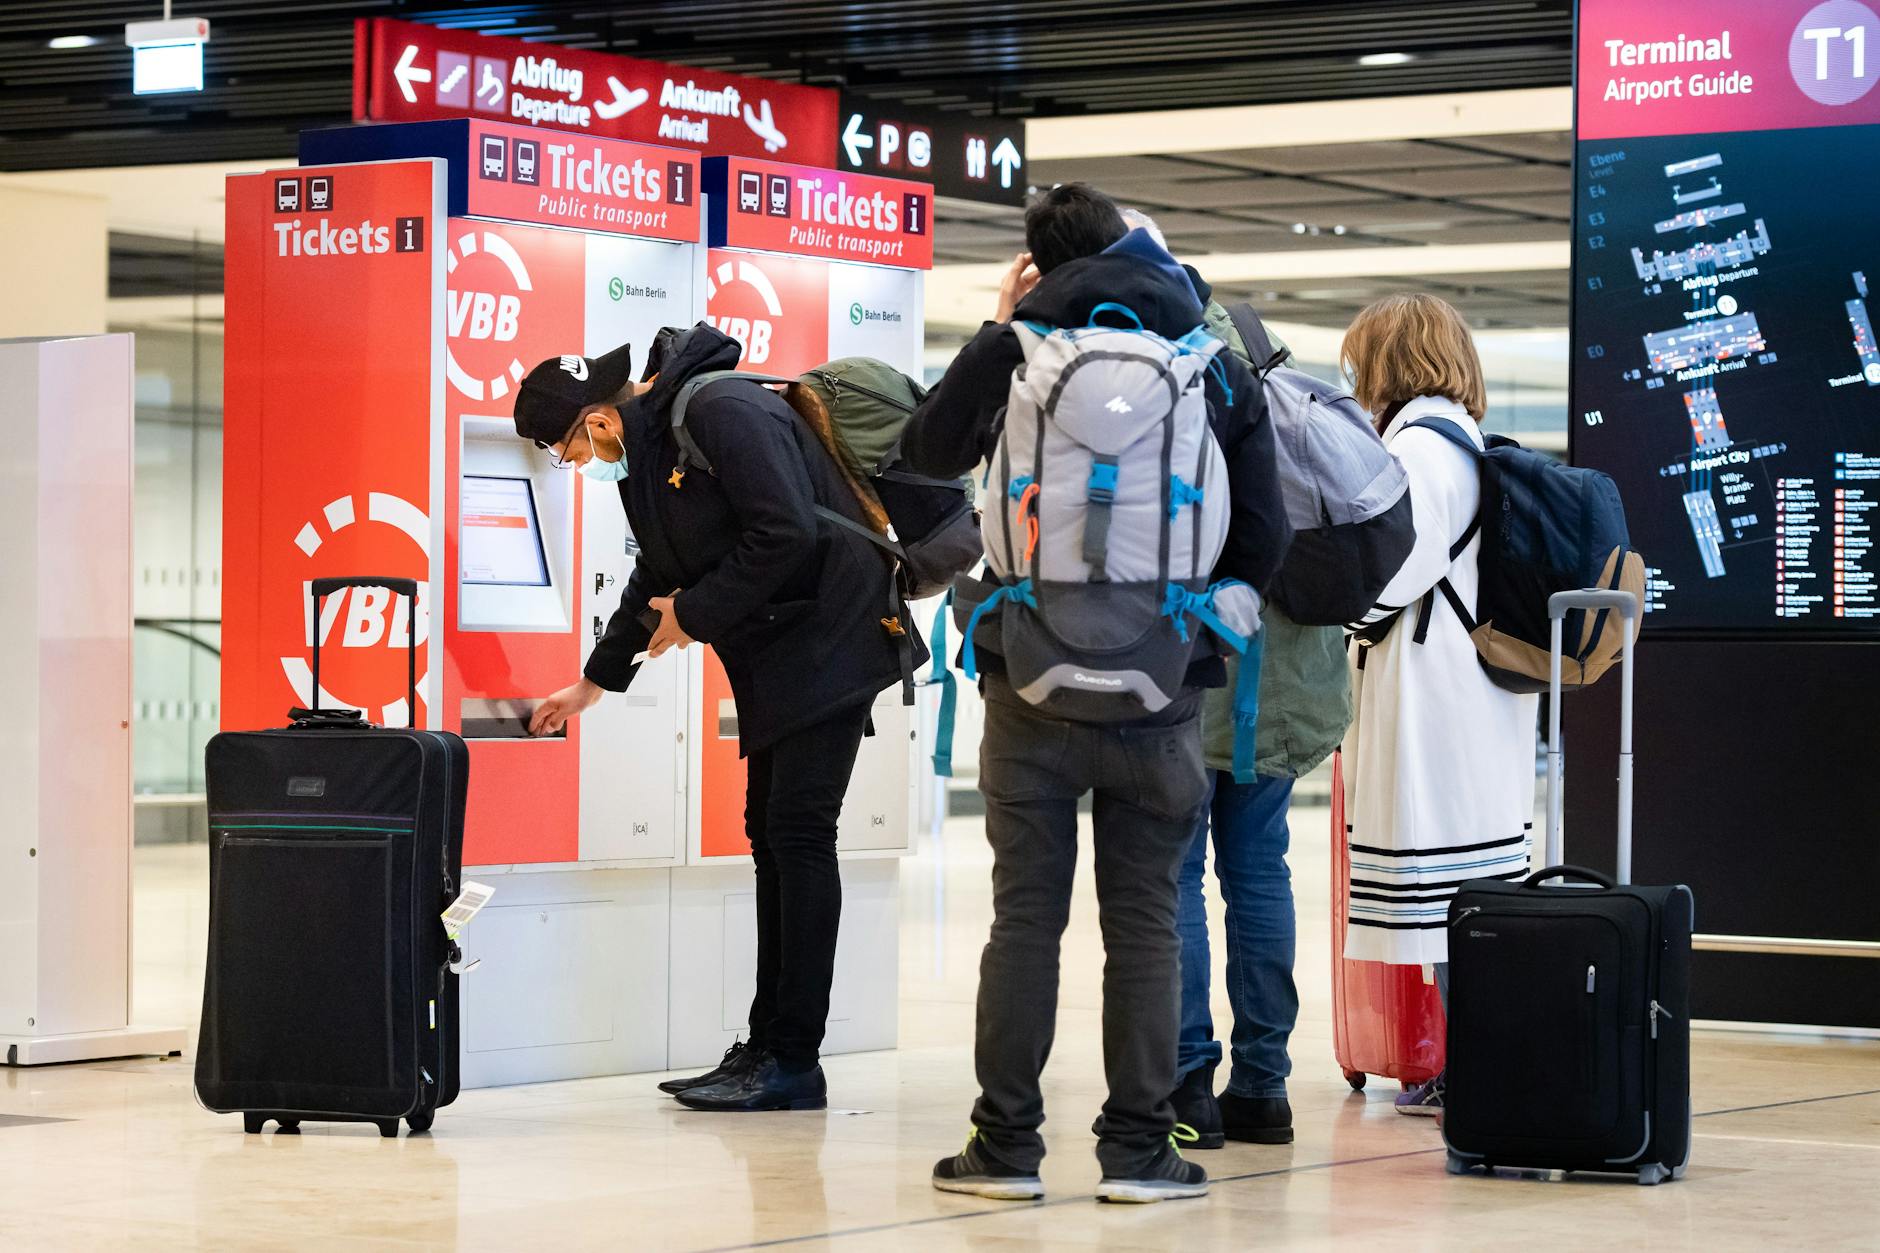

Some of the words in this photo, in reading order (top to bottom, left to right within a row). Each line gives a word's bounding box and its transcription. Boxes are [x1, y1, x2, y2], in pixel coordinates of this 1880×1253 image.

[1604, 31, 1732, 67] Terminal
[1803, 25, 1865, 80] T1
[511, 55, 584, 102] Abflug
[1603, 75, 1683, 105] Airport
[1689, 70, 1753, 96] Guide
[511, 92, 591, 127] Departure
[659, 78, 741, 118] Ankunft
[658, 114, 709, 144] Arrival
[879, 124, 901, 165] P
[1589, 151, 1626, 167] Ebene
[547, 143, 661, 202] Tickets
[1589, 184, 1606, 198] E4
[538, 194, 587, 218] Public
[593, 202, 668, 230] transport
[797, 178, 898, 232] Tickets
[1588, 212, 1605, 226] E3
[273, 218, 390, 257] Tickets
[789, 226, 832, 248] Public
[838, 234, 904, 258] transport
[1588, 235, 1605, 249] E2
[1587, 277, 1603, 290] E1
[1683, 275, 1718, 291] Abflug
[1718, 266, 1758, 282] Departure
[625, 285, 643, 297] Bahn
[645, 286, 667, 299] Berlin
[447, 289, 522, 342] VBB
[864, 310, 881, 321] Bahn
[882, 311, 902, 323] Berlin
[1683, 305, 1718, 320] Terminal
[1587, 344, 1604, 359] E0
[1676, 362, 1720, 382] Ankunft
[1720, 358, 1747, 373] Arrival
[1828, 372, 1865, 387] Terminal
[1584, 410, 1604, 426] U1
[1691, 454, 1728, 471] Airport
[1728, 450, 1750, 464] City
[1720, 472, 1744, 484] Willy-
[1723, 482, 1754, 495] Brandt-
[1725, 494, 1747, 505] Platz
